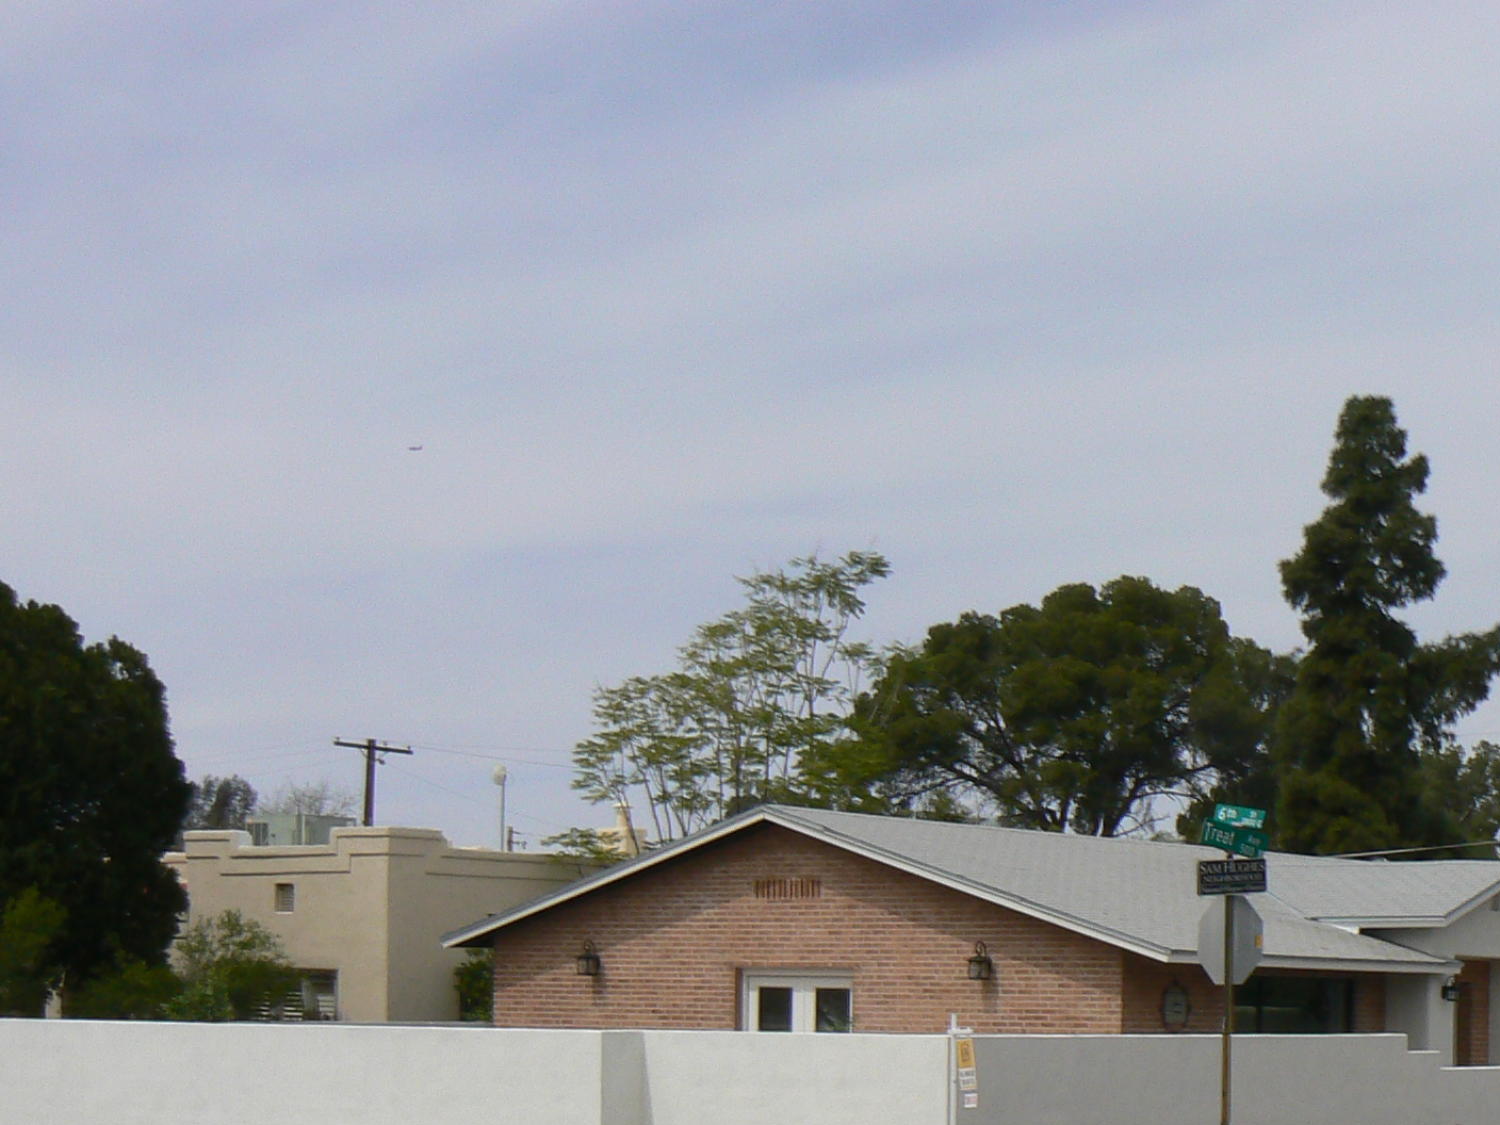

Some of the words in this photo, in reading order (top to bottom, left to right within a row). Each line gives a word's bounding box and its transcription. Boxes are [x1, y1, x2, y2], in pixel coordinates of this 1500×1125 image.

[1204, 822, 1235, 846] Treat
[1200, 863, 1222, 873] SAM
[1224, 862, 1264, 872] HUGHES
